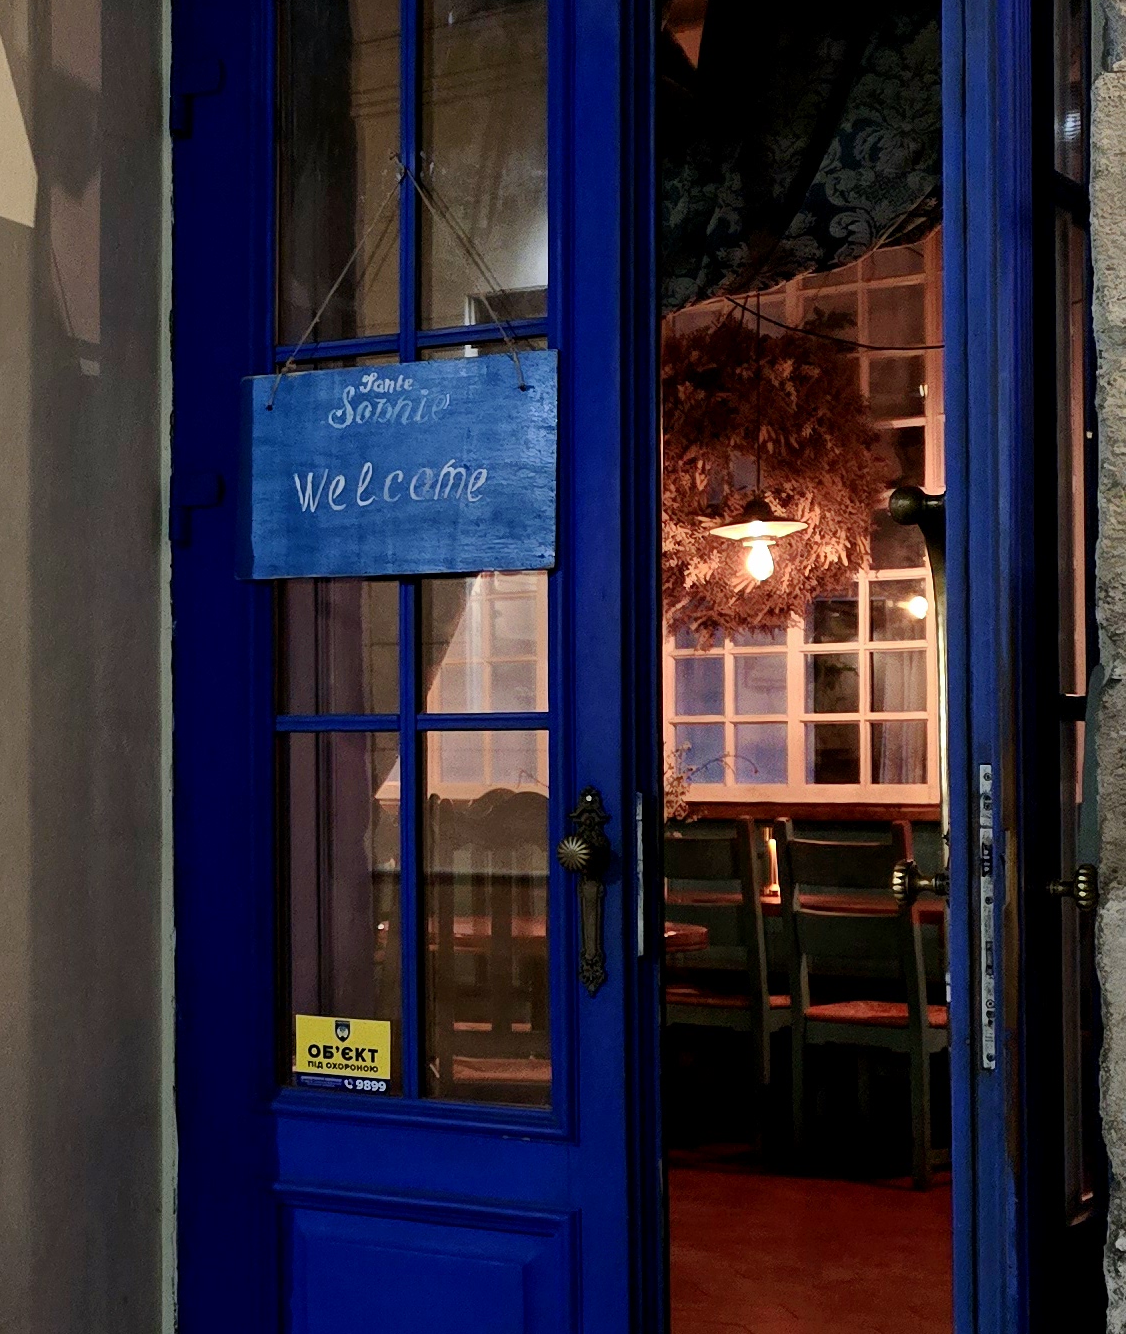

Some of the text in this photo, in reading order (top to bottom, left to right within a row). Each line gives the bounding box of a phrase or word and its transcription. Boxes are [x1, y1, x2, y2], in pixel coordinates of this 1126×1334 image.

[359, 372, 414, 394] Tante
[292, 458, 489, 513] Welcome
[307, 1060, 379, 1073] ПІД ОХОРОНОЮ
[355, 1079, 387, 1092] 9899
